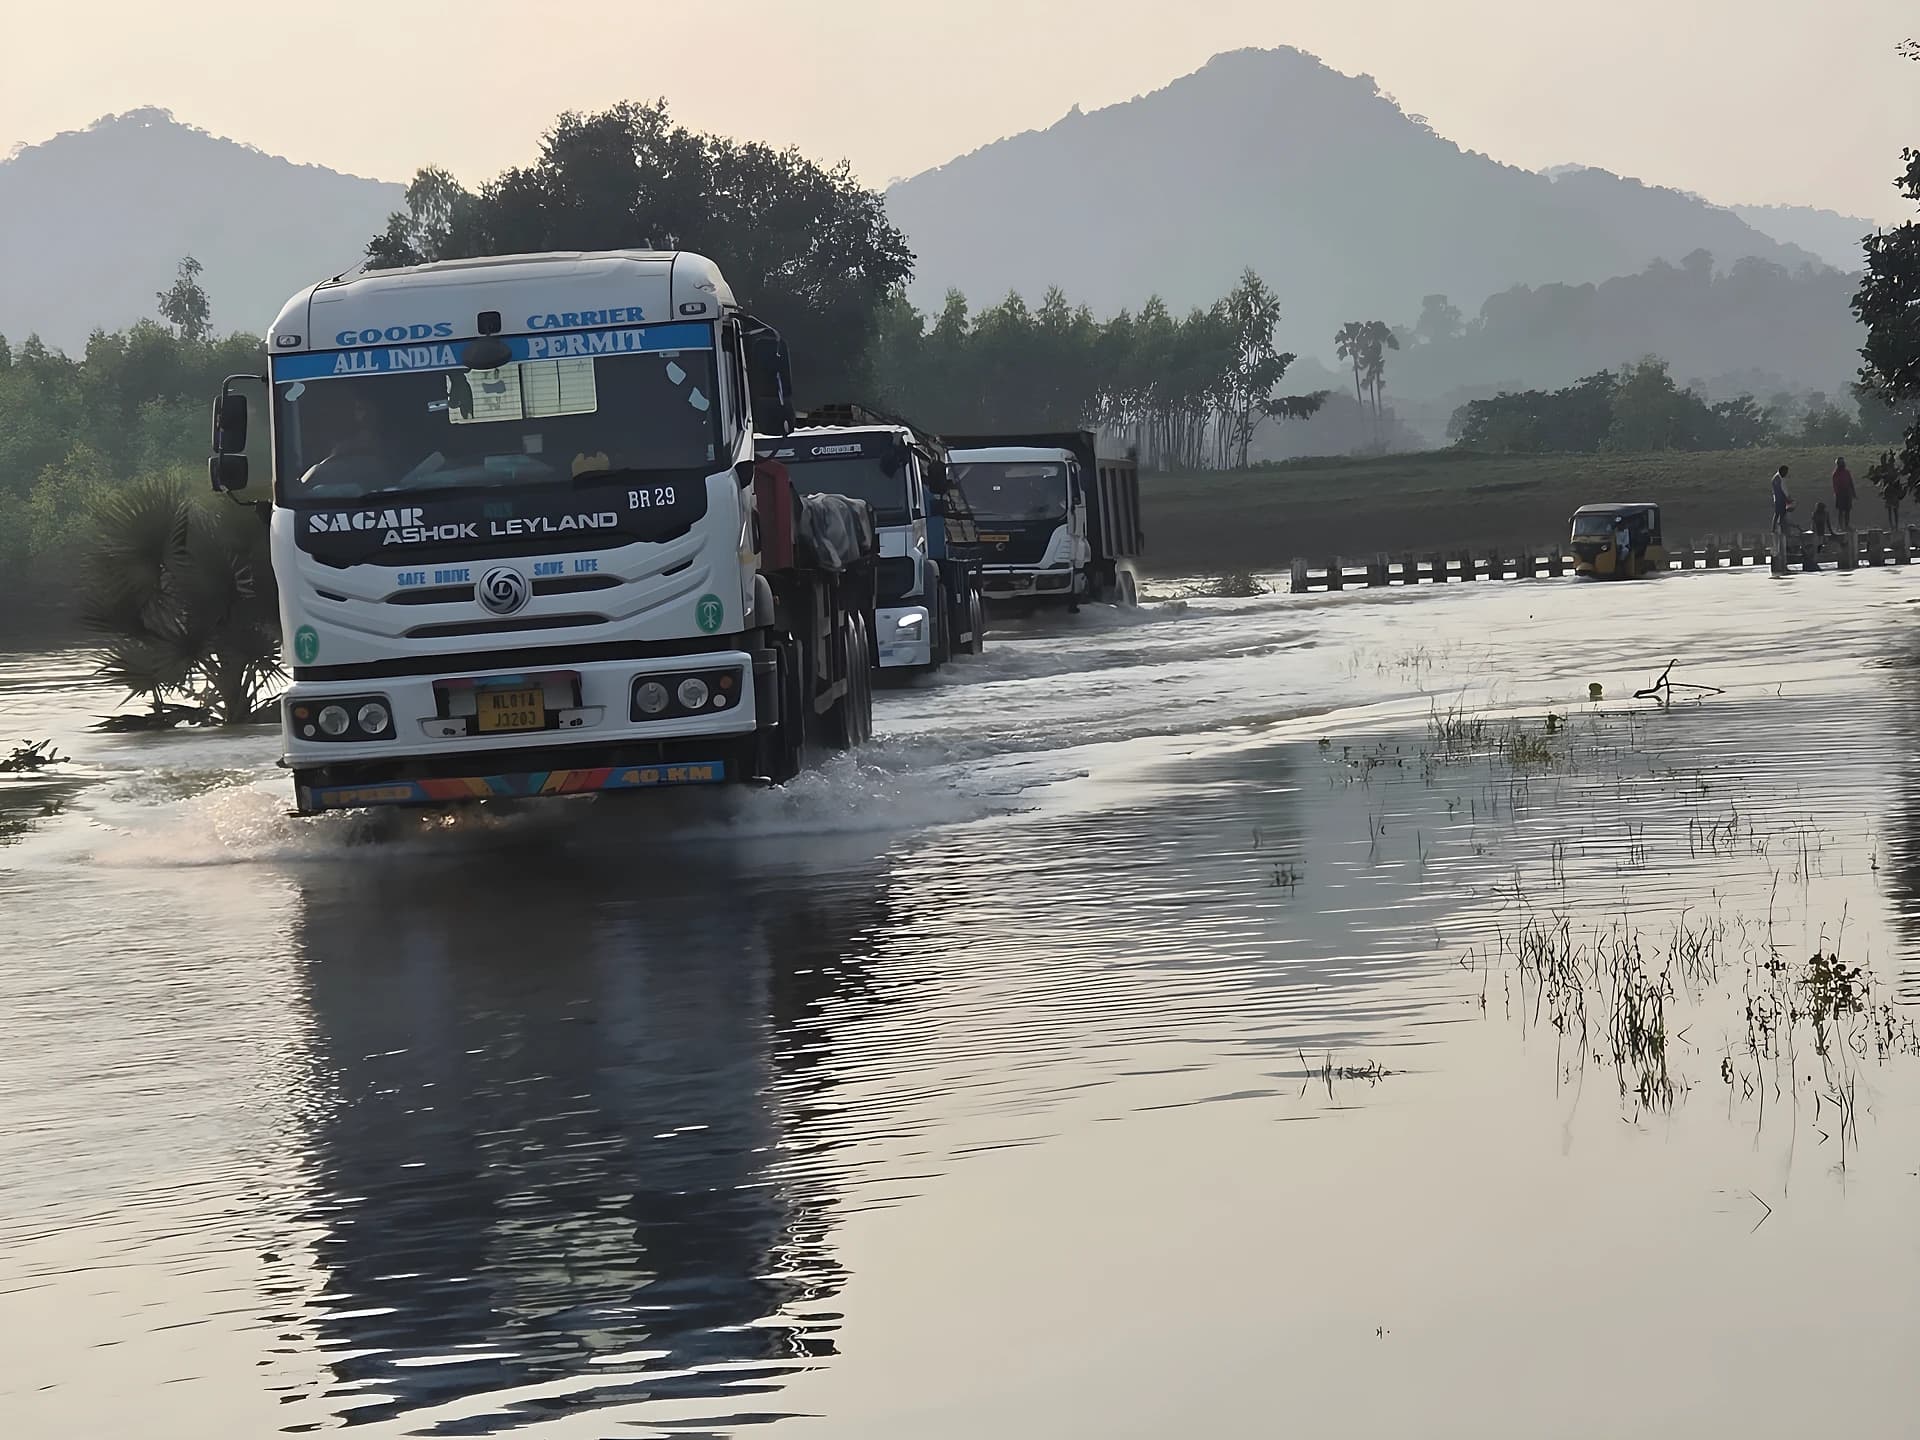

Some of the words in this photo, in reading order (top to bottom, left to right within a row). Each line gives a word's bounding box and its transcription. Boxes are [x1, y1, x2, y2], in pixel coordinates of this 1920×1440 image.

[335, 322, 453, 346] GOODS
[526, 306, 645, 330] CARRIER
[333, 351, 380, 374] ALL
[388, 344, 457, 370] INDIA
[527, 328, 646, 359] PERMIT
[628, 489, 651, 509] BR
[654, 486, 676, 506] 29
[309, 507, 425, 533] SAGAR
[383, 522, 479, 546] ASHOK
[490, 511, 618, 536] LEYLAND
[397, 571, 426, 586] SAFE
[434, 568, 470, 584] DRIVE
[534, 560, 564, 577] SAVE
[574, 558, 598, 573] LIFE
